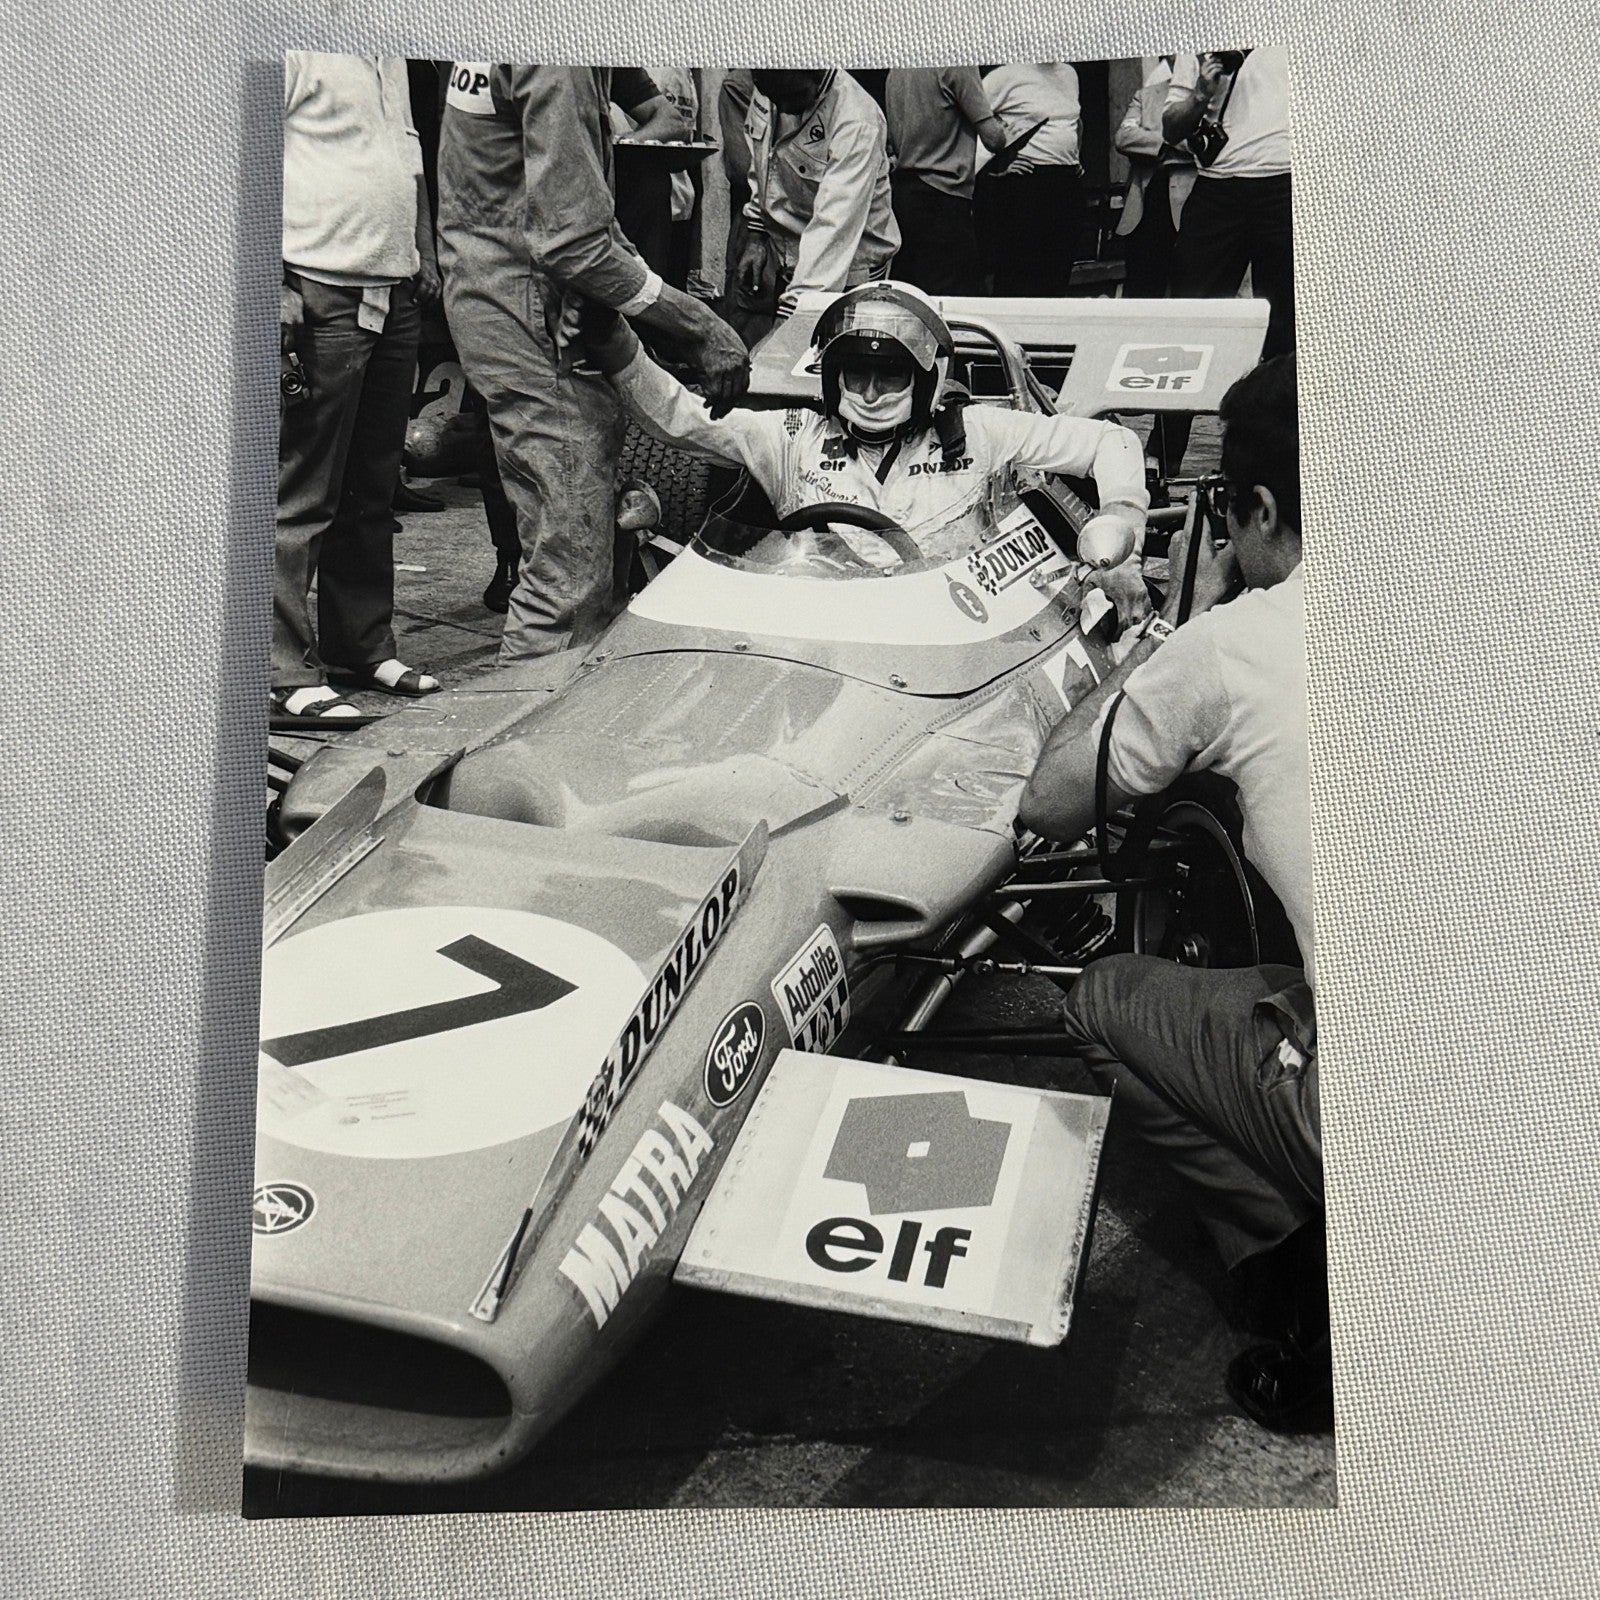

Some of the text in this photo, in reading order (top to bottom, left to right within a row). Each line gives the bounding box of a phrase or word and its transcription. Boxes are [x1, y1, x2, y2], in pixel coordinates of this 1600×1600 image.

[1119, 375, 1192, 390] elf
[819, 460, 847, 472] elf
[985, 525, 1049, 581] DUNLOP
[618, 868, 737, 1090] DUNLOP
[784, 945, 838, 1028] Autolite
[713, 1017, 758, 1092] Ford
[559, 1100, 714, 1330] MATRA
[806, 1217, 972, 1288] elf
